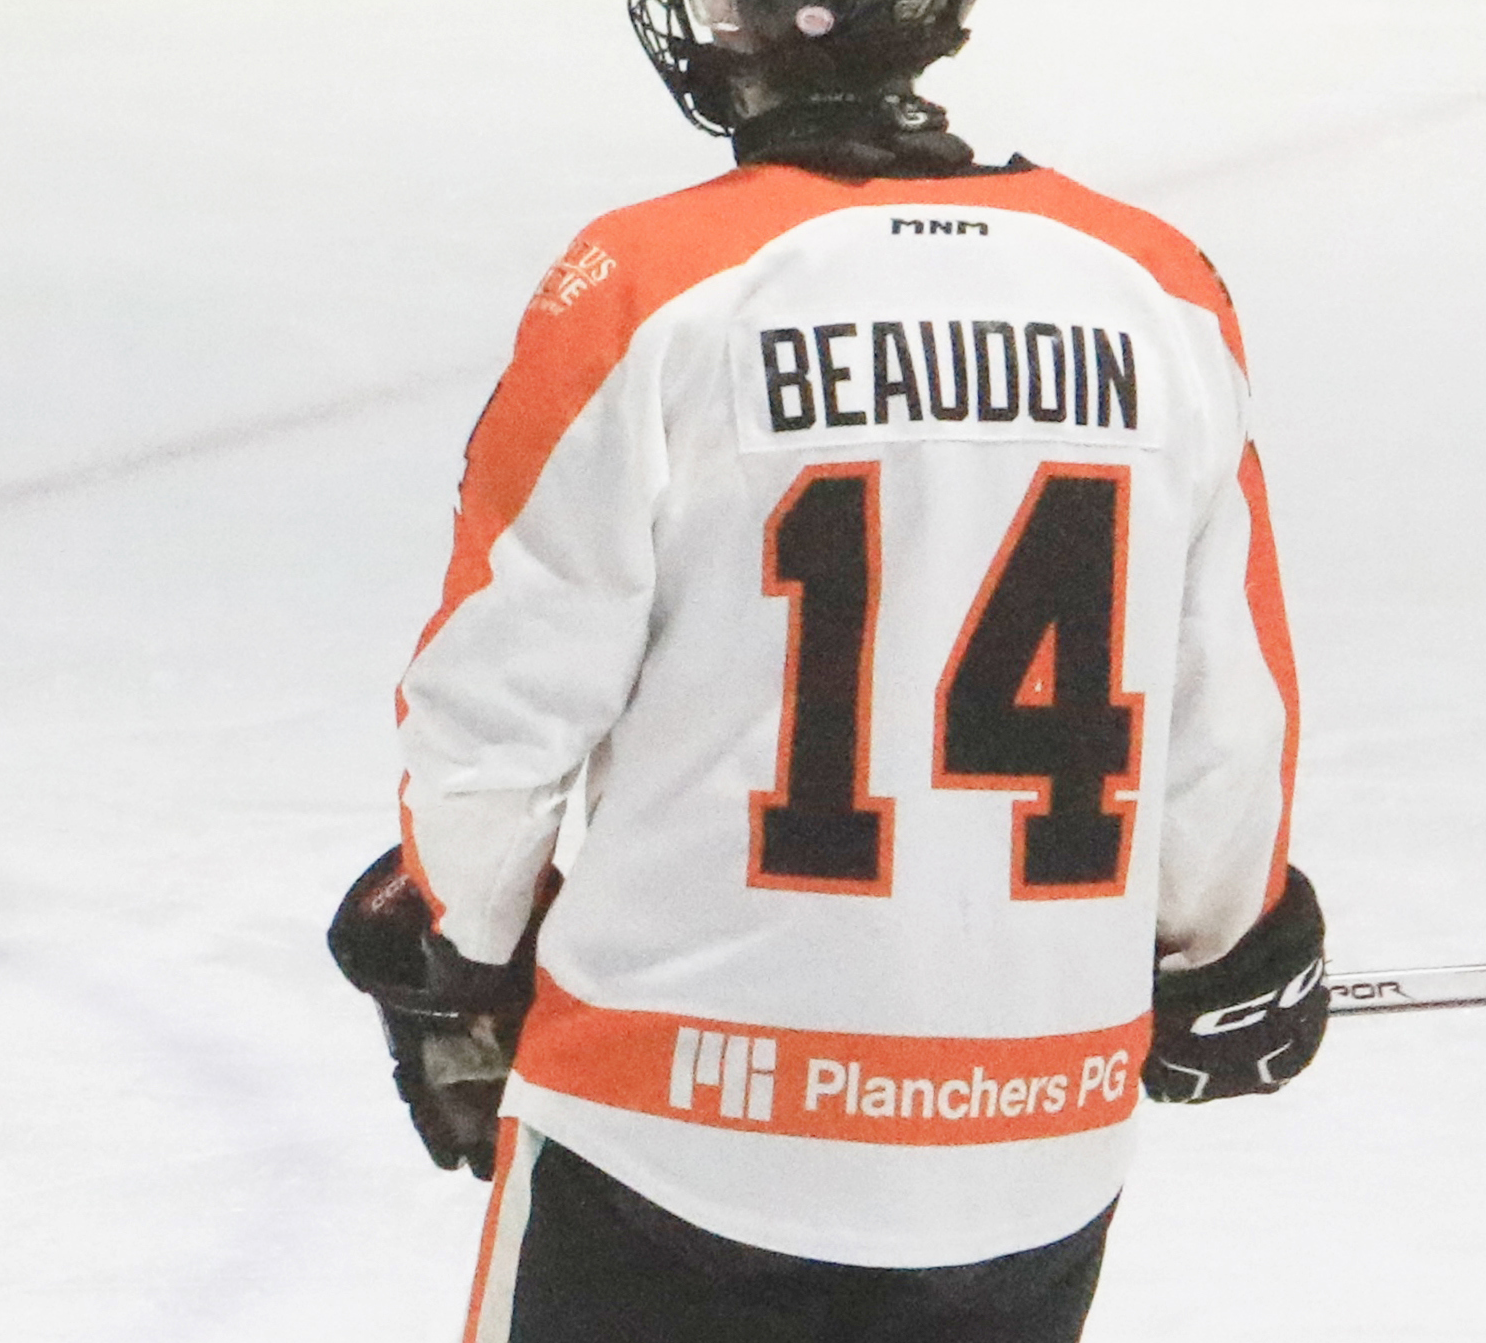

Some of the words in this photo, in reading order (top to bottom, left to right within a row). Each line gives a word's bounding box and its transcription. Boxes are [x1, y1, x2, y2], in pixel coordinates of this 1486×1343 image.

[890, 218, 989, 237] MNM
[759, 321, 1139, 433] BEAUDOIN
[745, 459, 1145, 902] 14
[1330, 980, 1407, 1001] POR
[806, 1058, 1068, 1124] Planchers
[1078, 1051, 1128, 1106] PG
